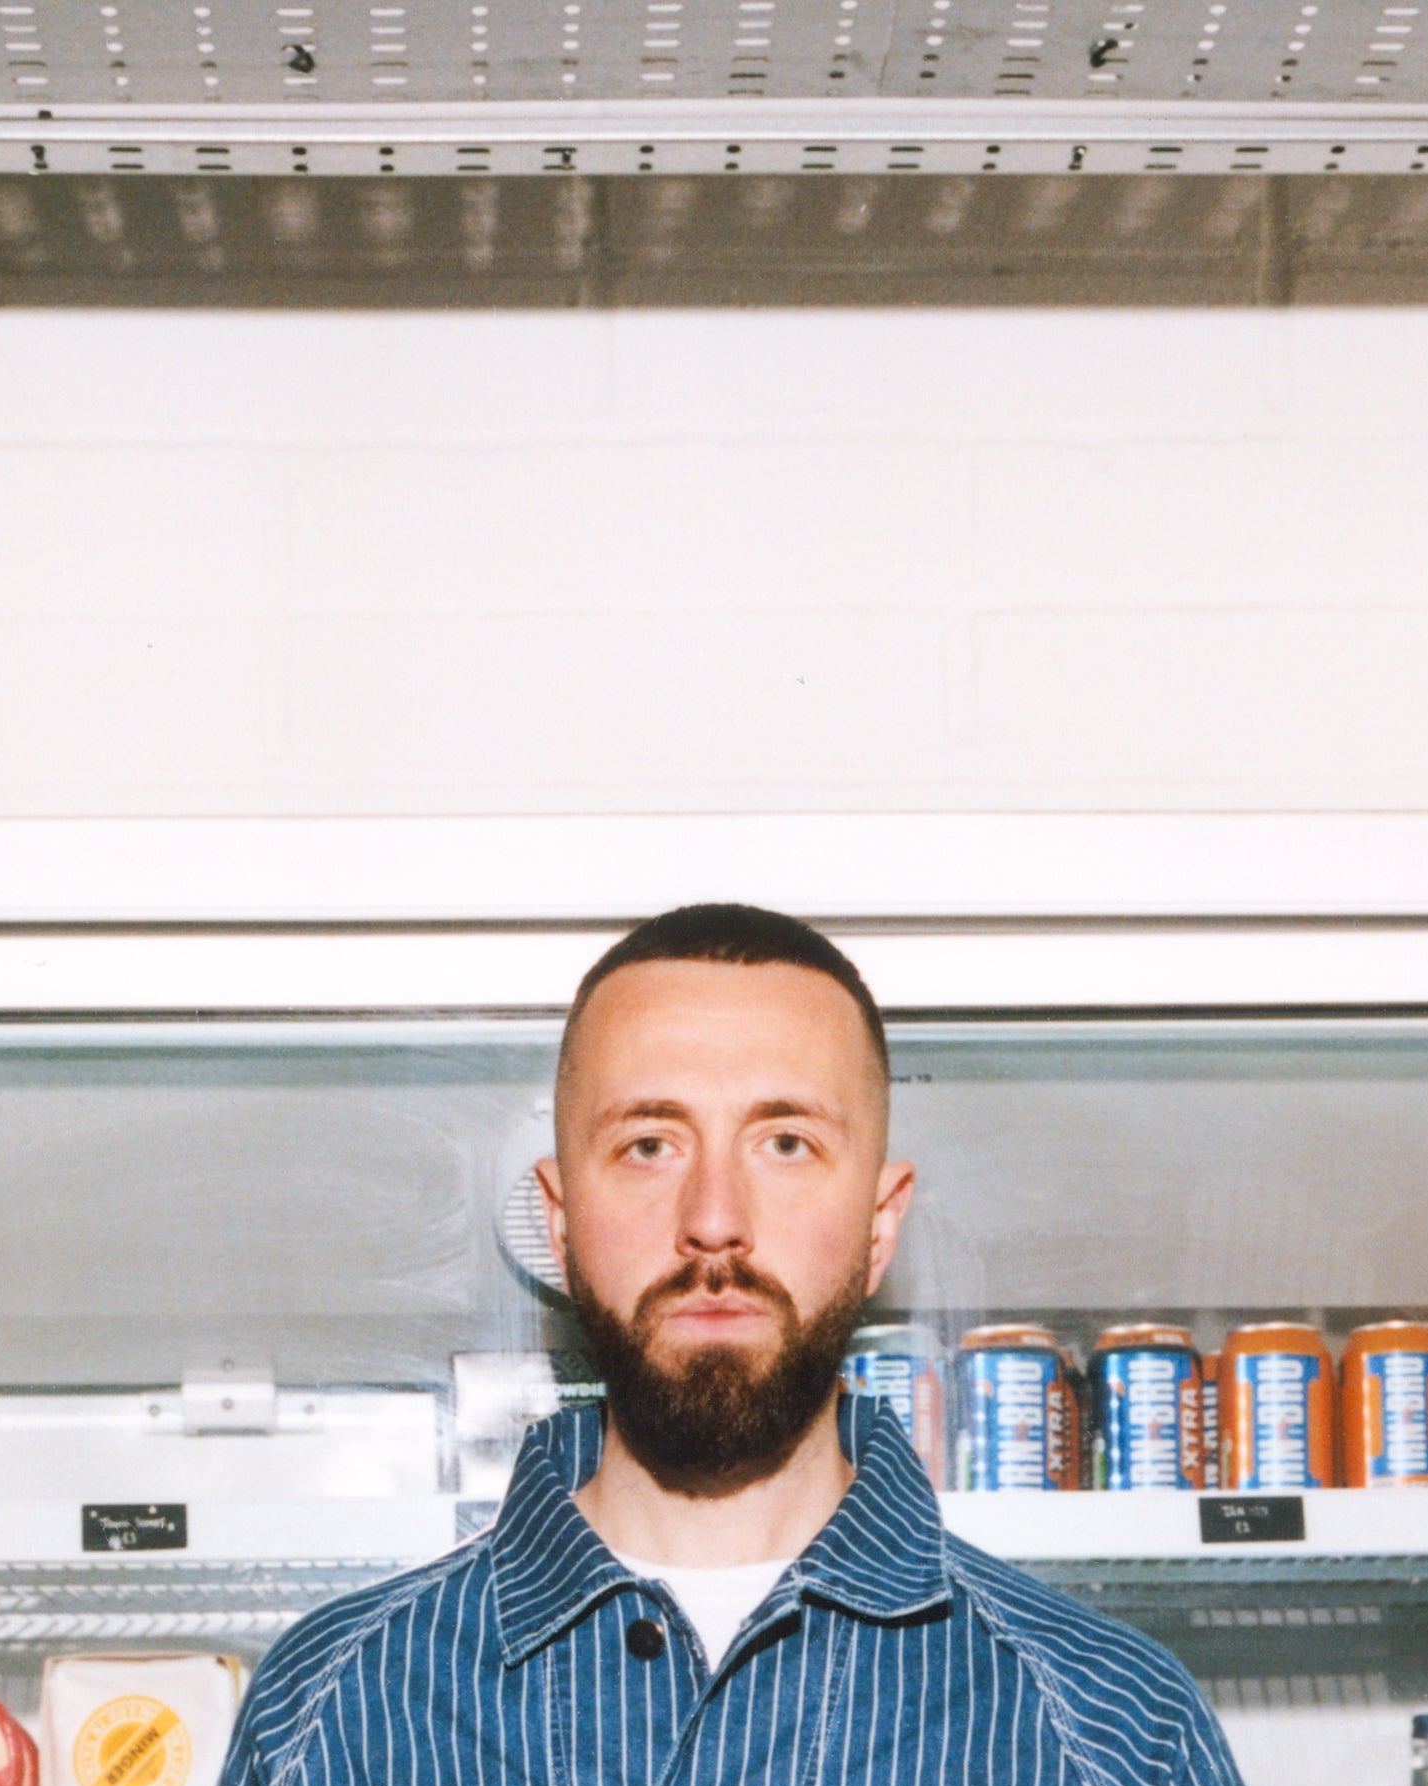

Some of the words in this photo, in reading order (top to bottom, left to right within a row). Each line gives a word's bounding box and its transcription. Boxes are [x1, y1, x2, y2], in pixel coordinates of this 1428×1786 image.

[1048, 1390, 1064, 1473] XTRA
[1181, 1388, 1199, 1469] XTRA
[106, 1725, 160, 1786] MINGER
